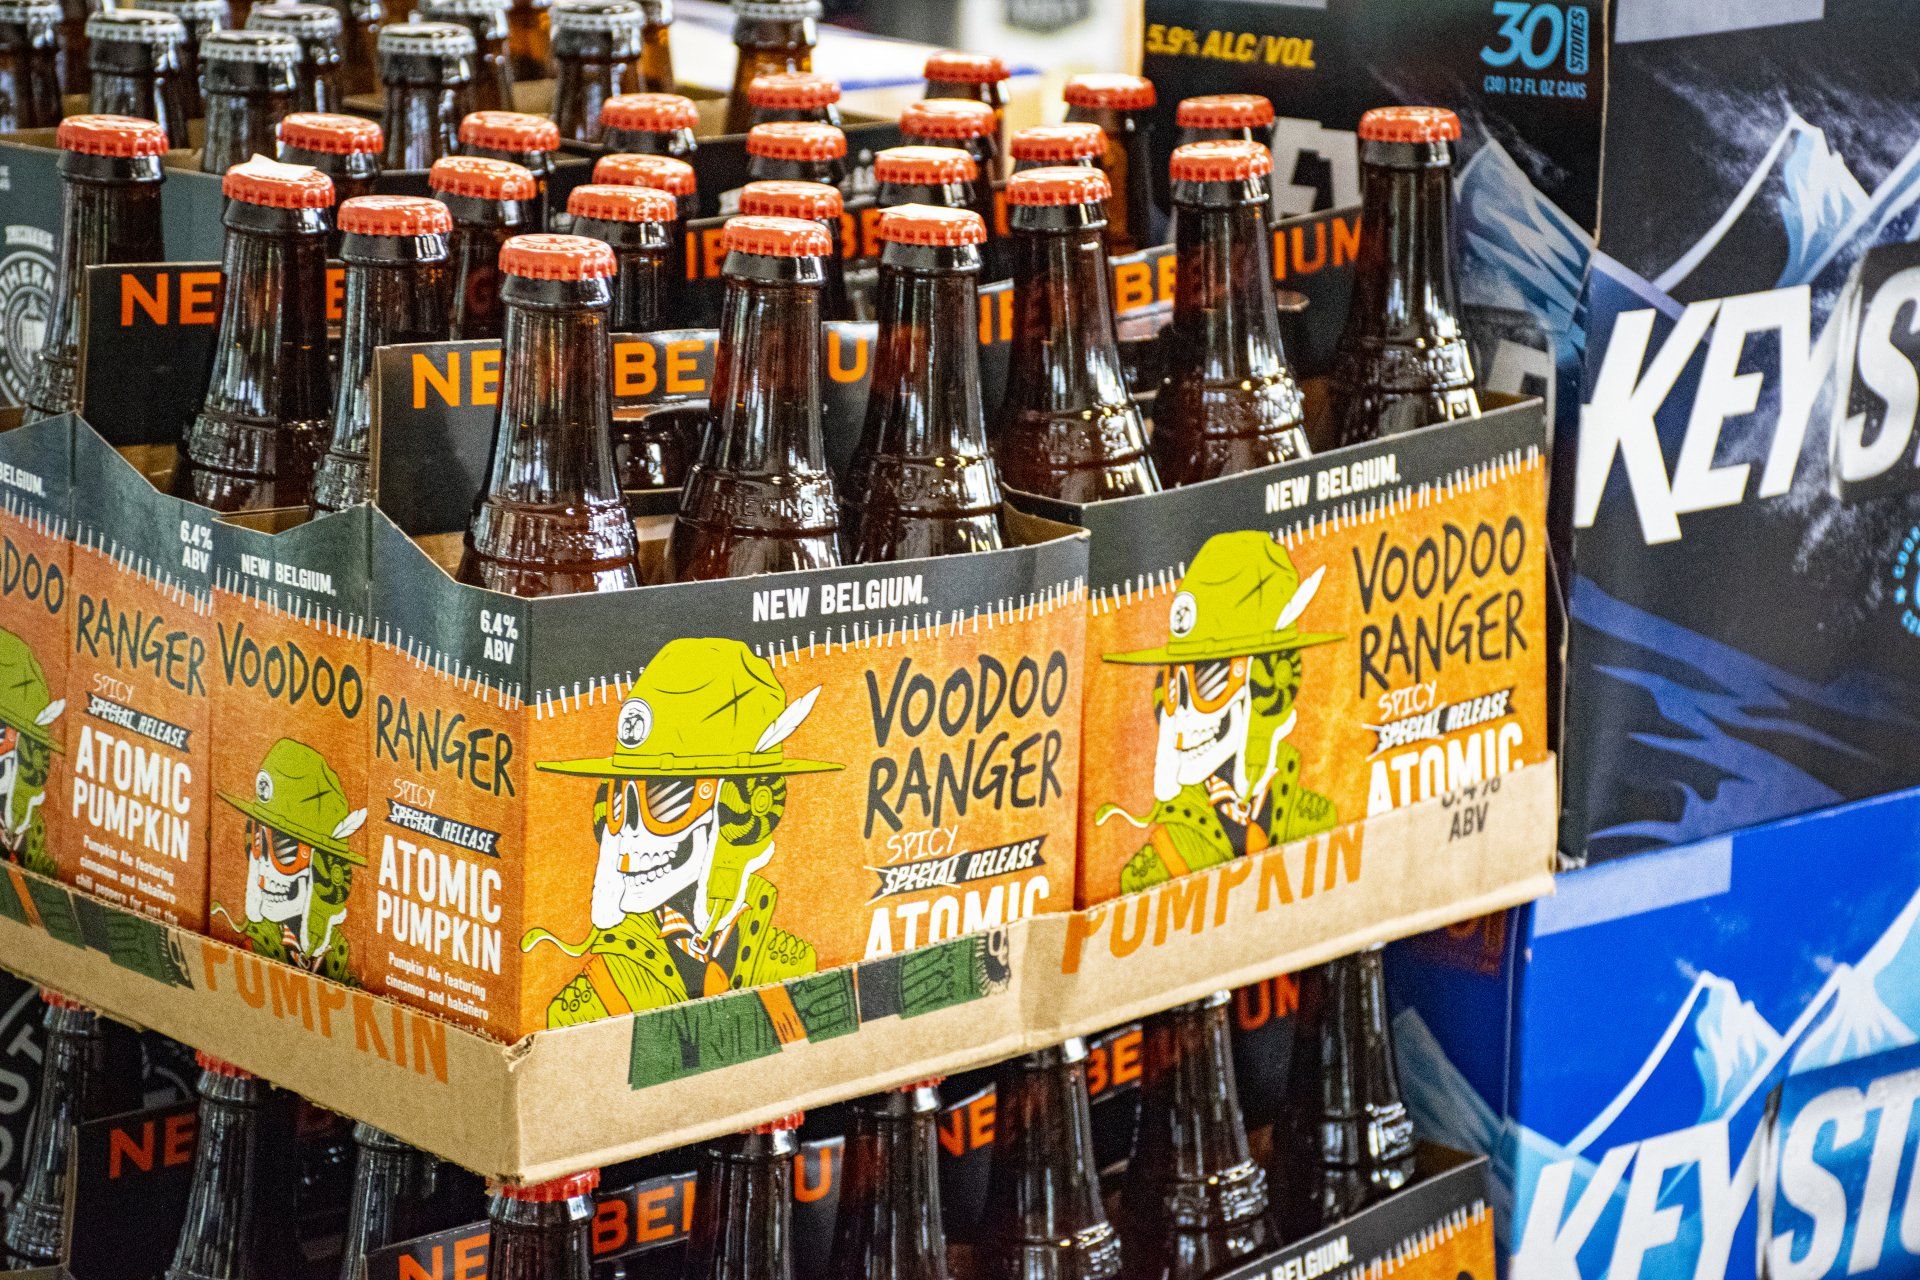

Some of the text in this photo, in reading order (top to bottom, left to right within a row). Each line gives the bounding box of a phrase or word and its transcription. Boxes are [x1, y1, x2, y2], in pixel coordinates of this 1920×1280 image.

[1201, 30, 1317, 69] ALC/VOL
[1480, 1, 1564, 70] 30
[1570, 9, 1586, 71] STONES
[1509, 76, 1522, 95] 12
[1524, 77, 1538, 96] FL
[1540, 78, 1555, 97] OZ
[1557, 80, 1588, 99] CANS
[121, 271, 222, 327] NE
[412, 350, 502, 409] NE
[1573, 266, 1920, 546] KEYS
[1265, 474, 1311, 514] NEW
[180, 520, 213, 551] 6.4%
[182, 545, 210, 574] ABV
[0, 535, 65, 615] DOO
[241, 553, 271, 580] NEW
[1352, 514, 1528, 614] VOODOO
[480, 609, 519, 640] 6.4%
[752, 586, 810, 622] NEW
[76, 594, 206, 697] RANGER
[483, 636, 515, 665] ABV
[1359, 588, 1528, 699] RANGER
[93, 672, 135, 704] SPICY
[217, 621, 364, 719] VOODOO
[864, 649, 1069, 749] VOODOO
[1377, 680, 1437, 721] SPICY
[1446, 689, 1510, 732] RELEASE
[137, 715, 188, 748] RELEASE
[375, 694, 516, 798] RANGER
[75, 725, 192, 815] ATOMIC
[393, 778, 436, 810] SPICY
[863, 729, 1063, 840] RANGER
[72, 776, 190, 863] PUMPKIN
[390, 804, 495, 854] SPECIAL RELEASE
[886, 824, 959, 864] SPICY
[1449, 802, 1489, 842] ABV
[80, 855, 118, 881] cinnamon
[120, 873, 136, 888] and
[83, 834, 175, 887] Pumpkin Ale featuring
[378, 834, 502, 924] ATOMIC
[882, 839, 1040, 895] SPECIAL RELEASE
[376, 889, 502, 976] PUMPKIN
[385, 973, 426, 999] cinnamon
[428, 990, 445, 1006] and
[388, 951, 486, 1002] Pumpkin Ale featuring
[201, 942, 449, 1085] PUMPKIN
[109, 1112, 197, 1180] NE
[399, 1232, 491, 1280] NE
